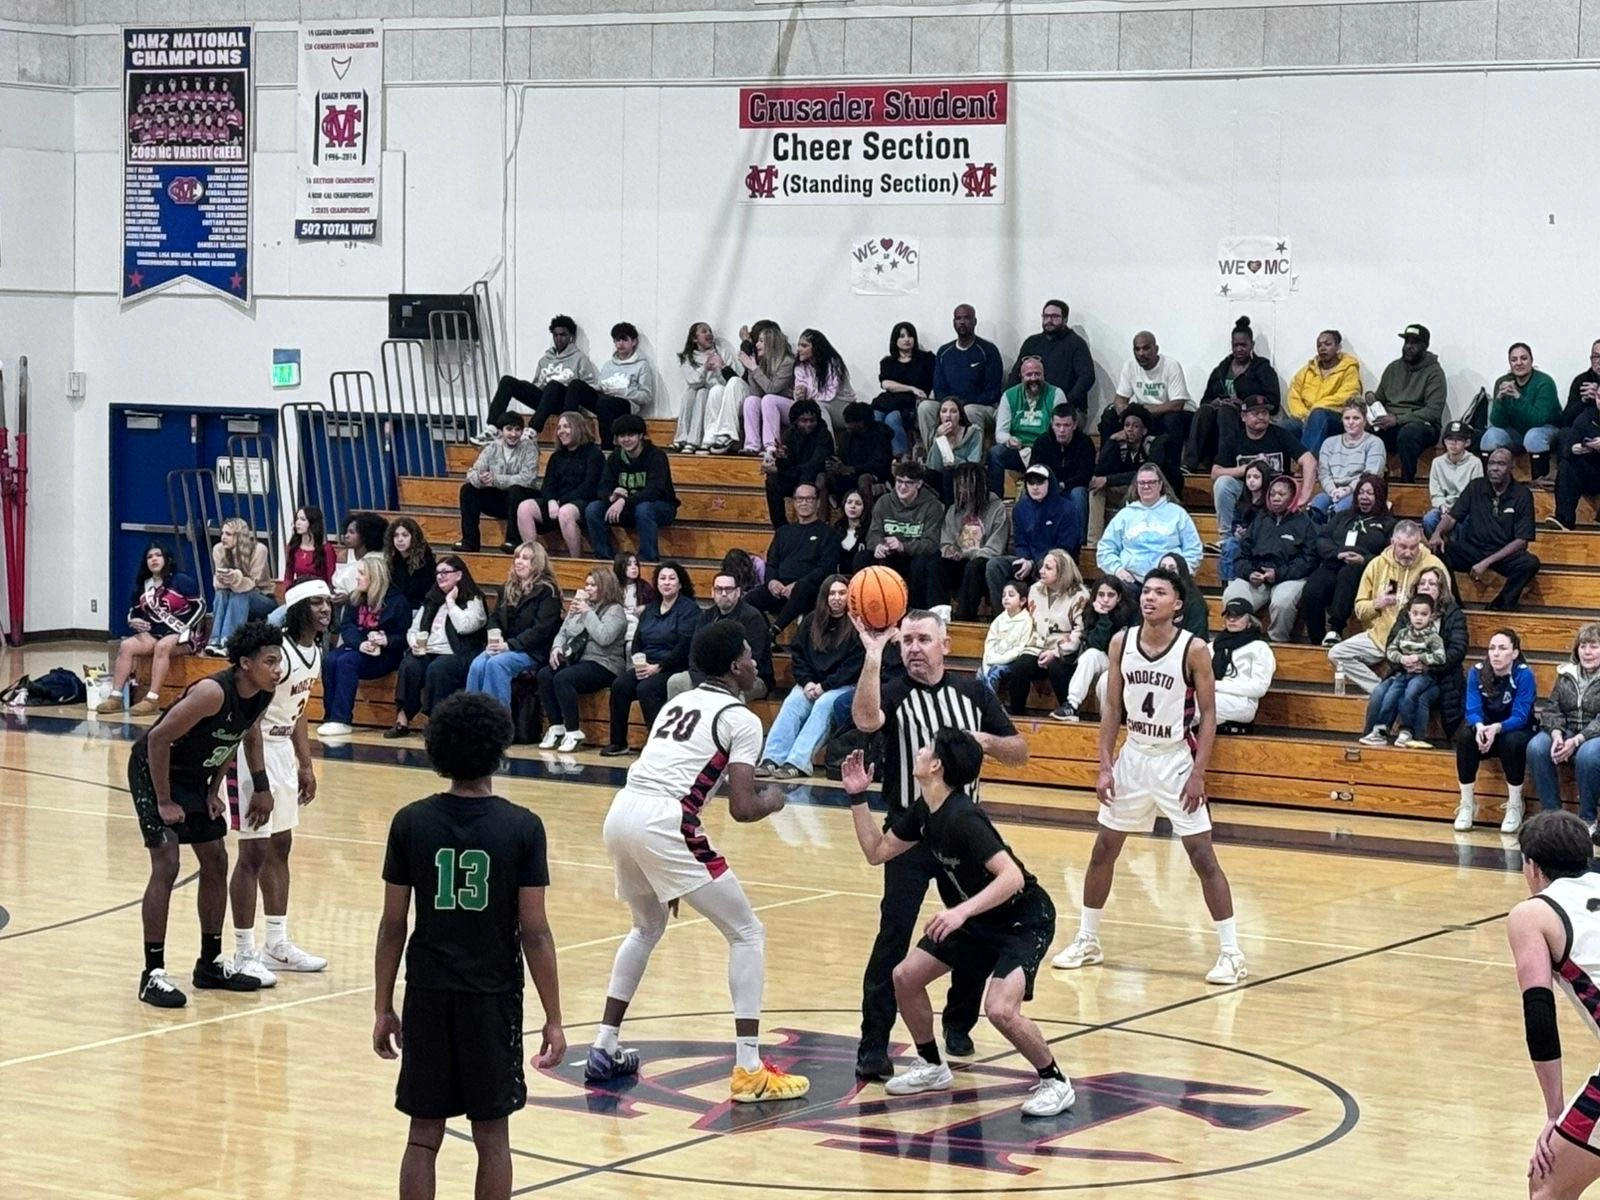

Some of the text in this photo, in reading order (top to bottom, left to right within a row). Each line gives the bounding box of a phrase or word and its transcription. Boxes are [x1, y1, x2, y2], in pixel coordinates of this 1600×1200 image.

[173, 32, 246, 48] NATIONAL
[131, 49, 242, 66] CHAMPIONS
[749, 89, 998, 124] Crusader Student
[173, 145, 212, 159] VARSITY
[213, 145, 242, 159] CHEER
[773, 131, 970, 161] Cheer Section
[782, 172, 959, 197] (Standing Section)
[301, 222, 374, 235] 502 TOTAL WINS
[853, 239, 917, 264] WE MC
[1218, 259, 1289, 275] WE MC
[1126, 670, 1174, 690] MODESTO
[1141, 692, 1155, 718] 4
[653, 705, 702, 742] 20
[1127, 719, 1172, 738] CHRISTIAN
[435, 848, 490, 911] 13
